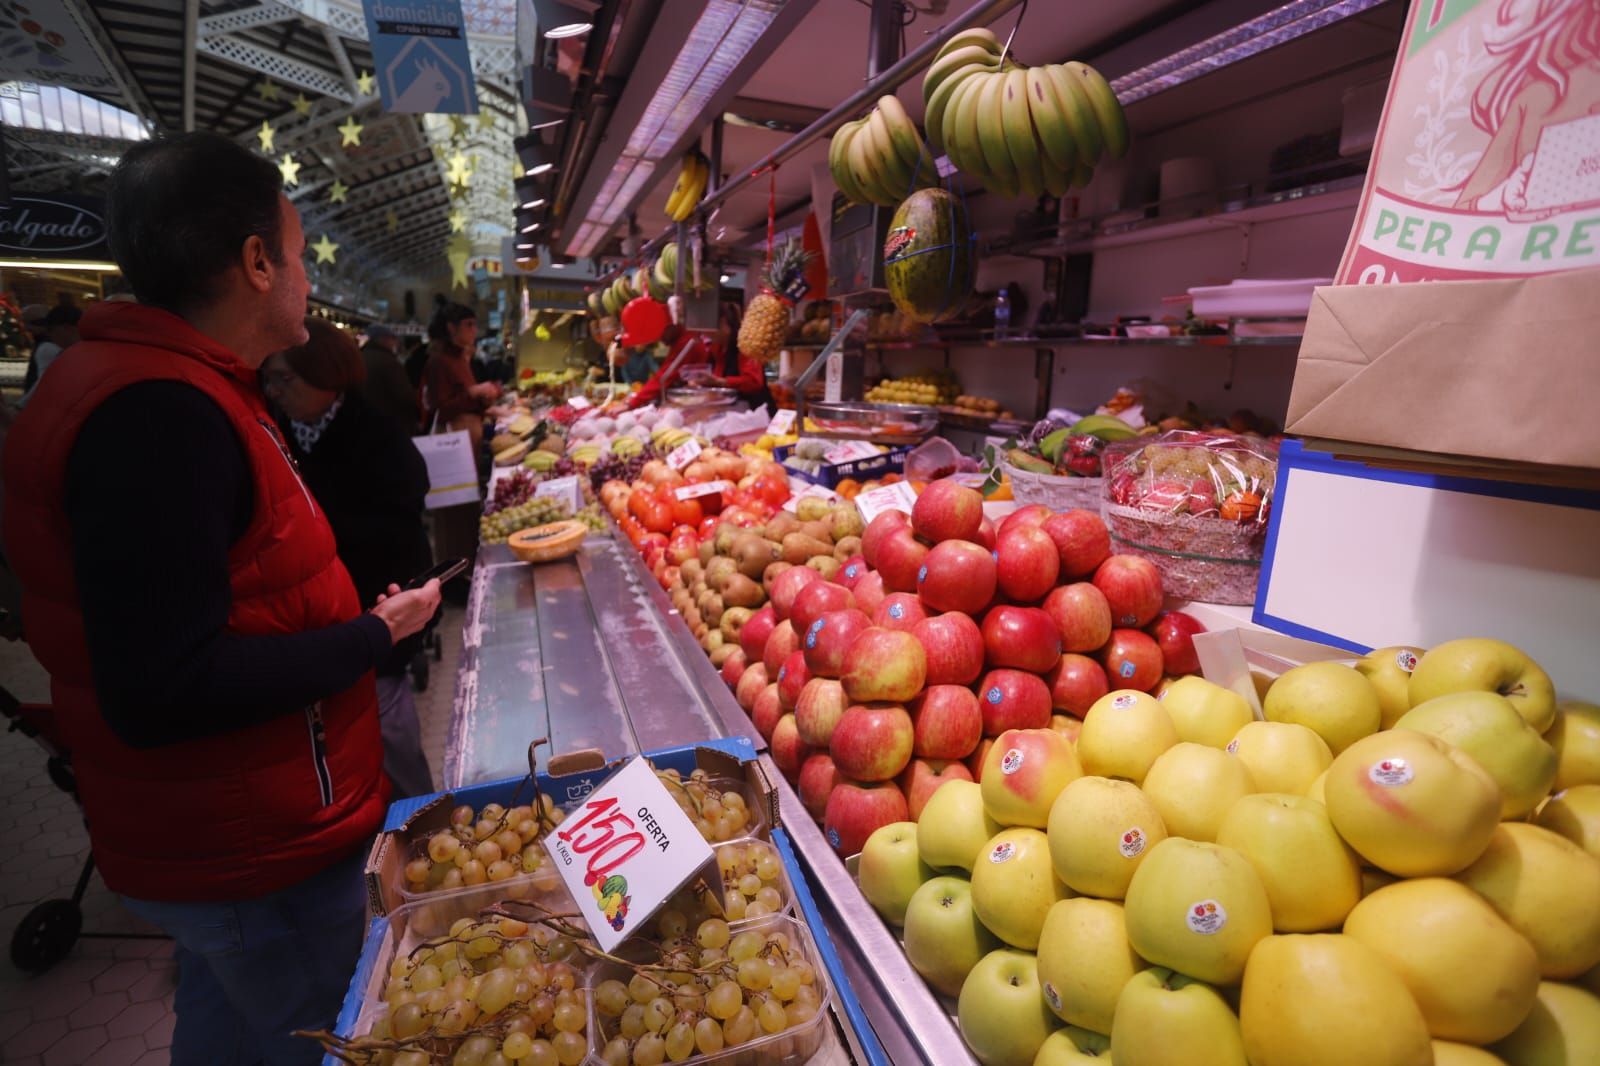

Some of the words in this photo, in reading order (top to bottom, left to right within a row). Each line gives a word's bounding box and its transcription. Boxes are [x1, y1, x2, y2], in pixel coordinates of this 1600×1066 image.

[0, 207, 93, 247] olgado
[1373, 208, 1453, 257] PER
[1463, 224, 1502, 261] A
[637, 806, 673, 853] OFERTA
